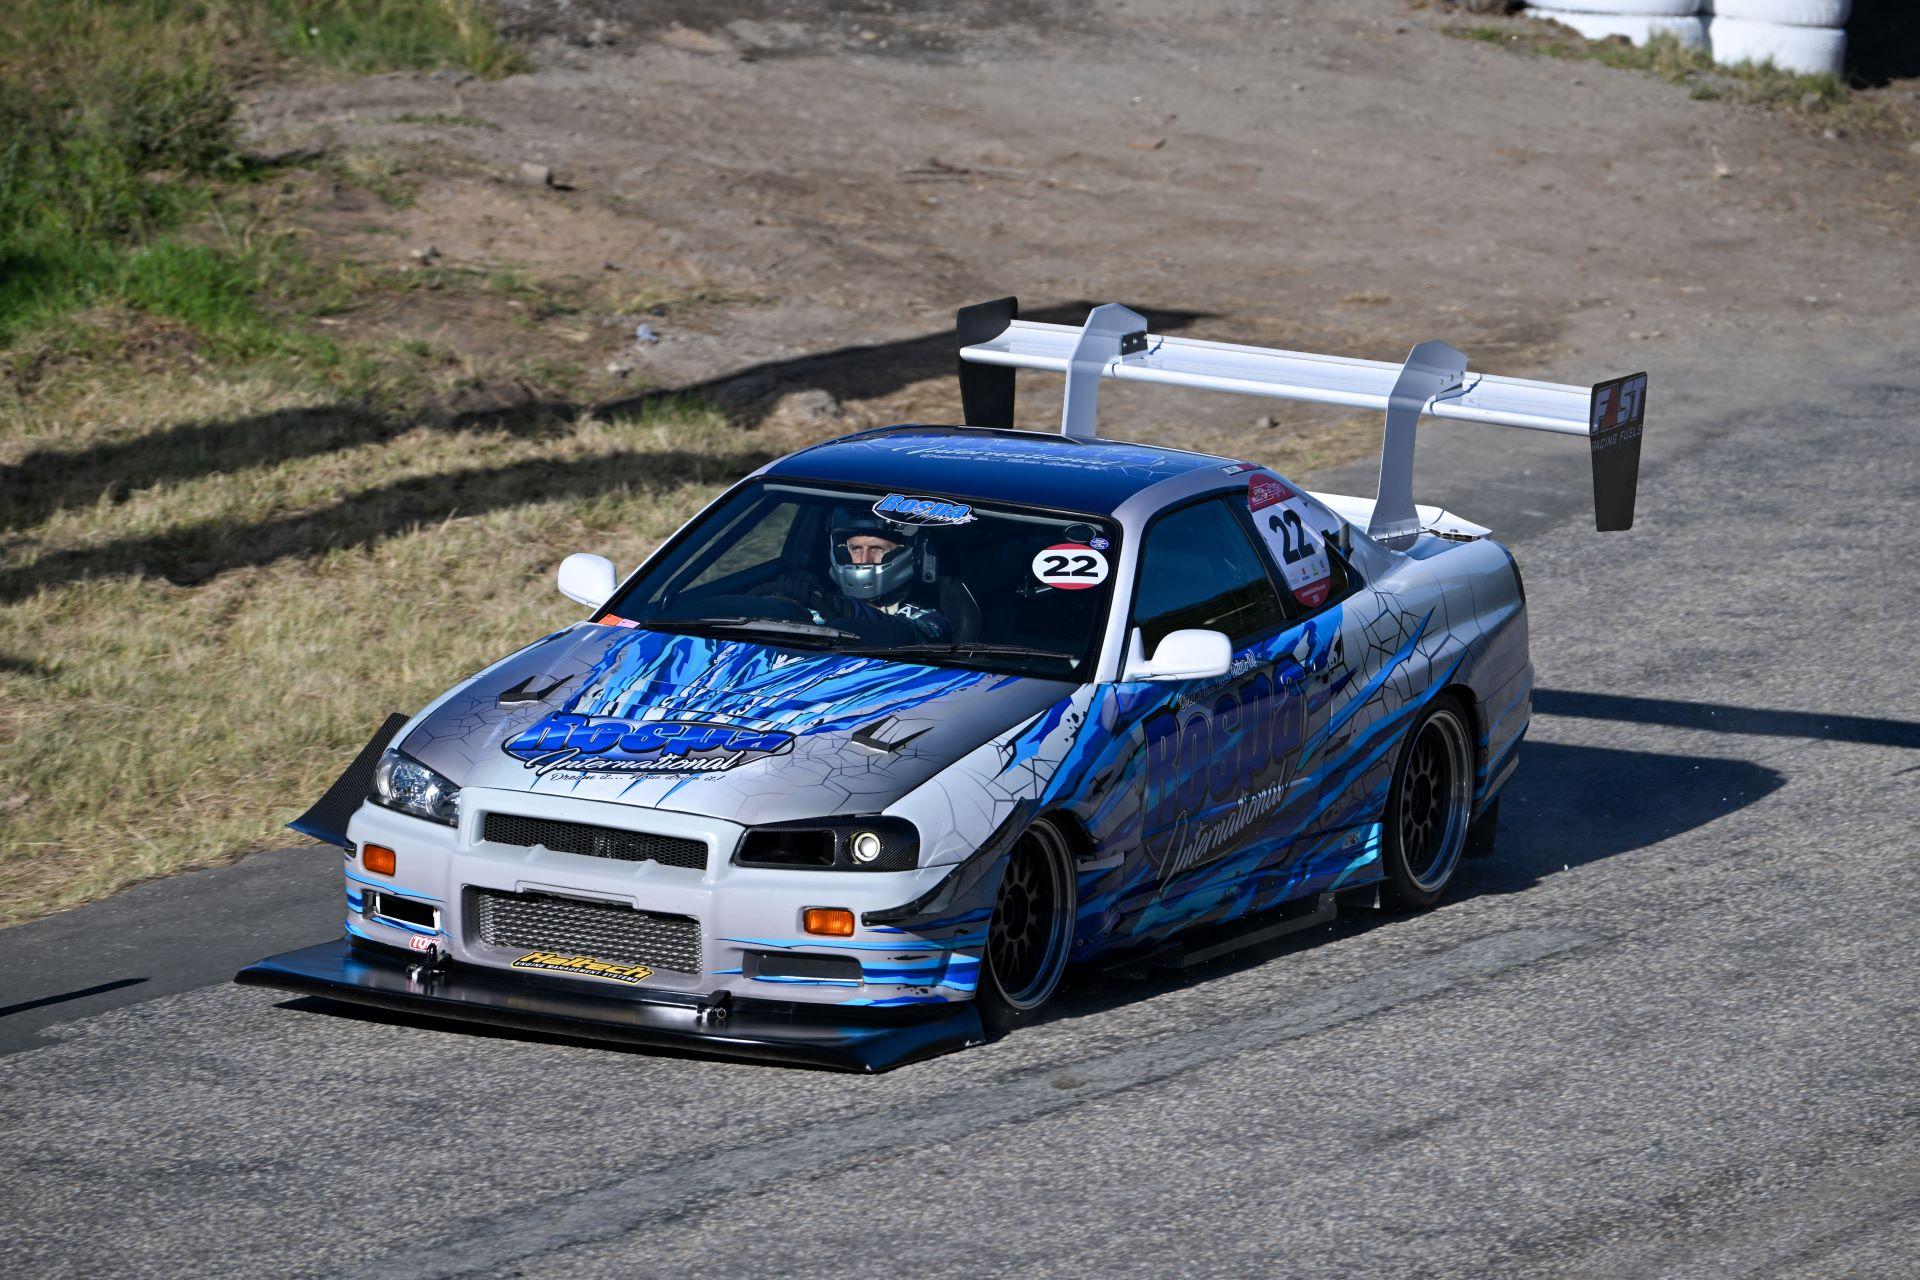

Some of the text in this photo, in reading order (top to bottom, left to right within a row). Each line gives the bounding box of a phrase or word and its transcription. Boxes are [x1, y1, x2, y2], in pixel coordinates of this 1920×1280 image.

[1592, 424, 1643, 452] RACING FUELS
[1269, 509, 1316, 565] 22
[1042, 555, 1099, 578] 22
[525, 748, 746, 775] International
[1155, 758, 1288, 893] International
[412, 936, 440, 950] TOW
[514, 961, 638, 982] ENGINE MANAGEMENT SYSTEMS
[520, 952, 653, 979] Haltech
